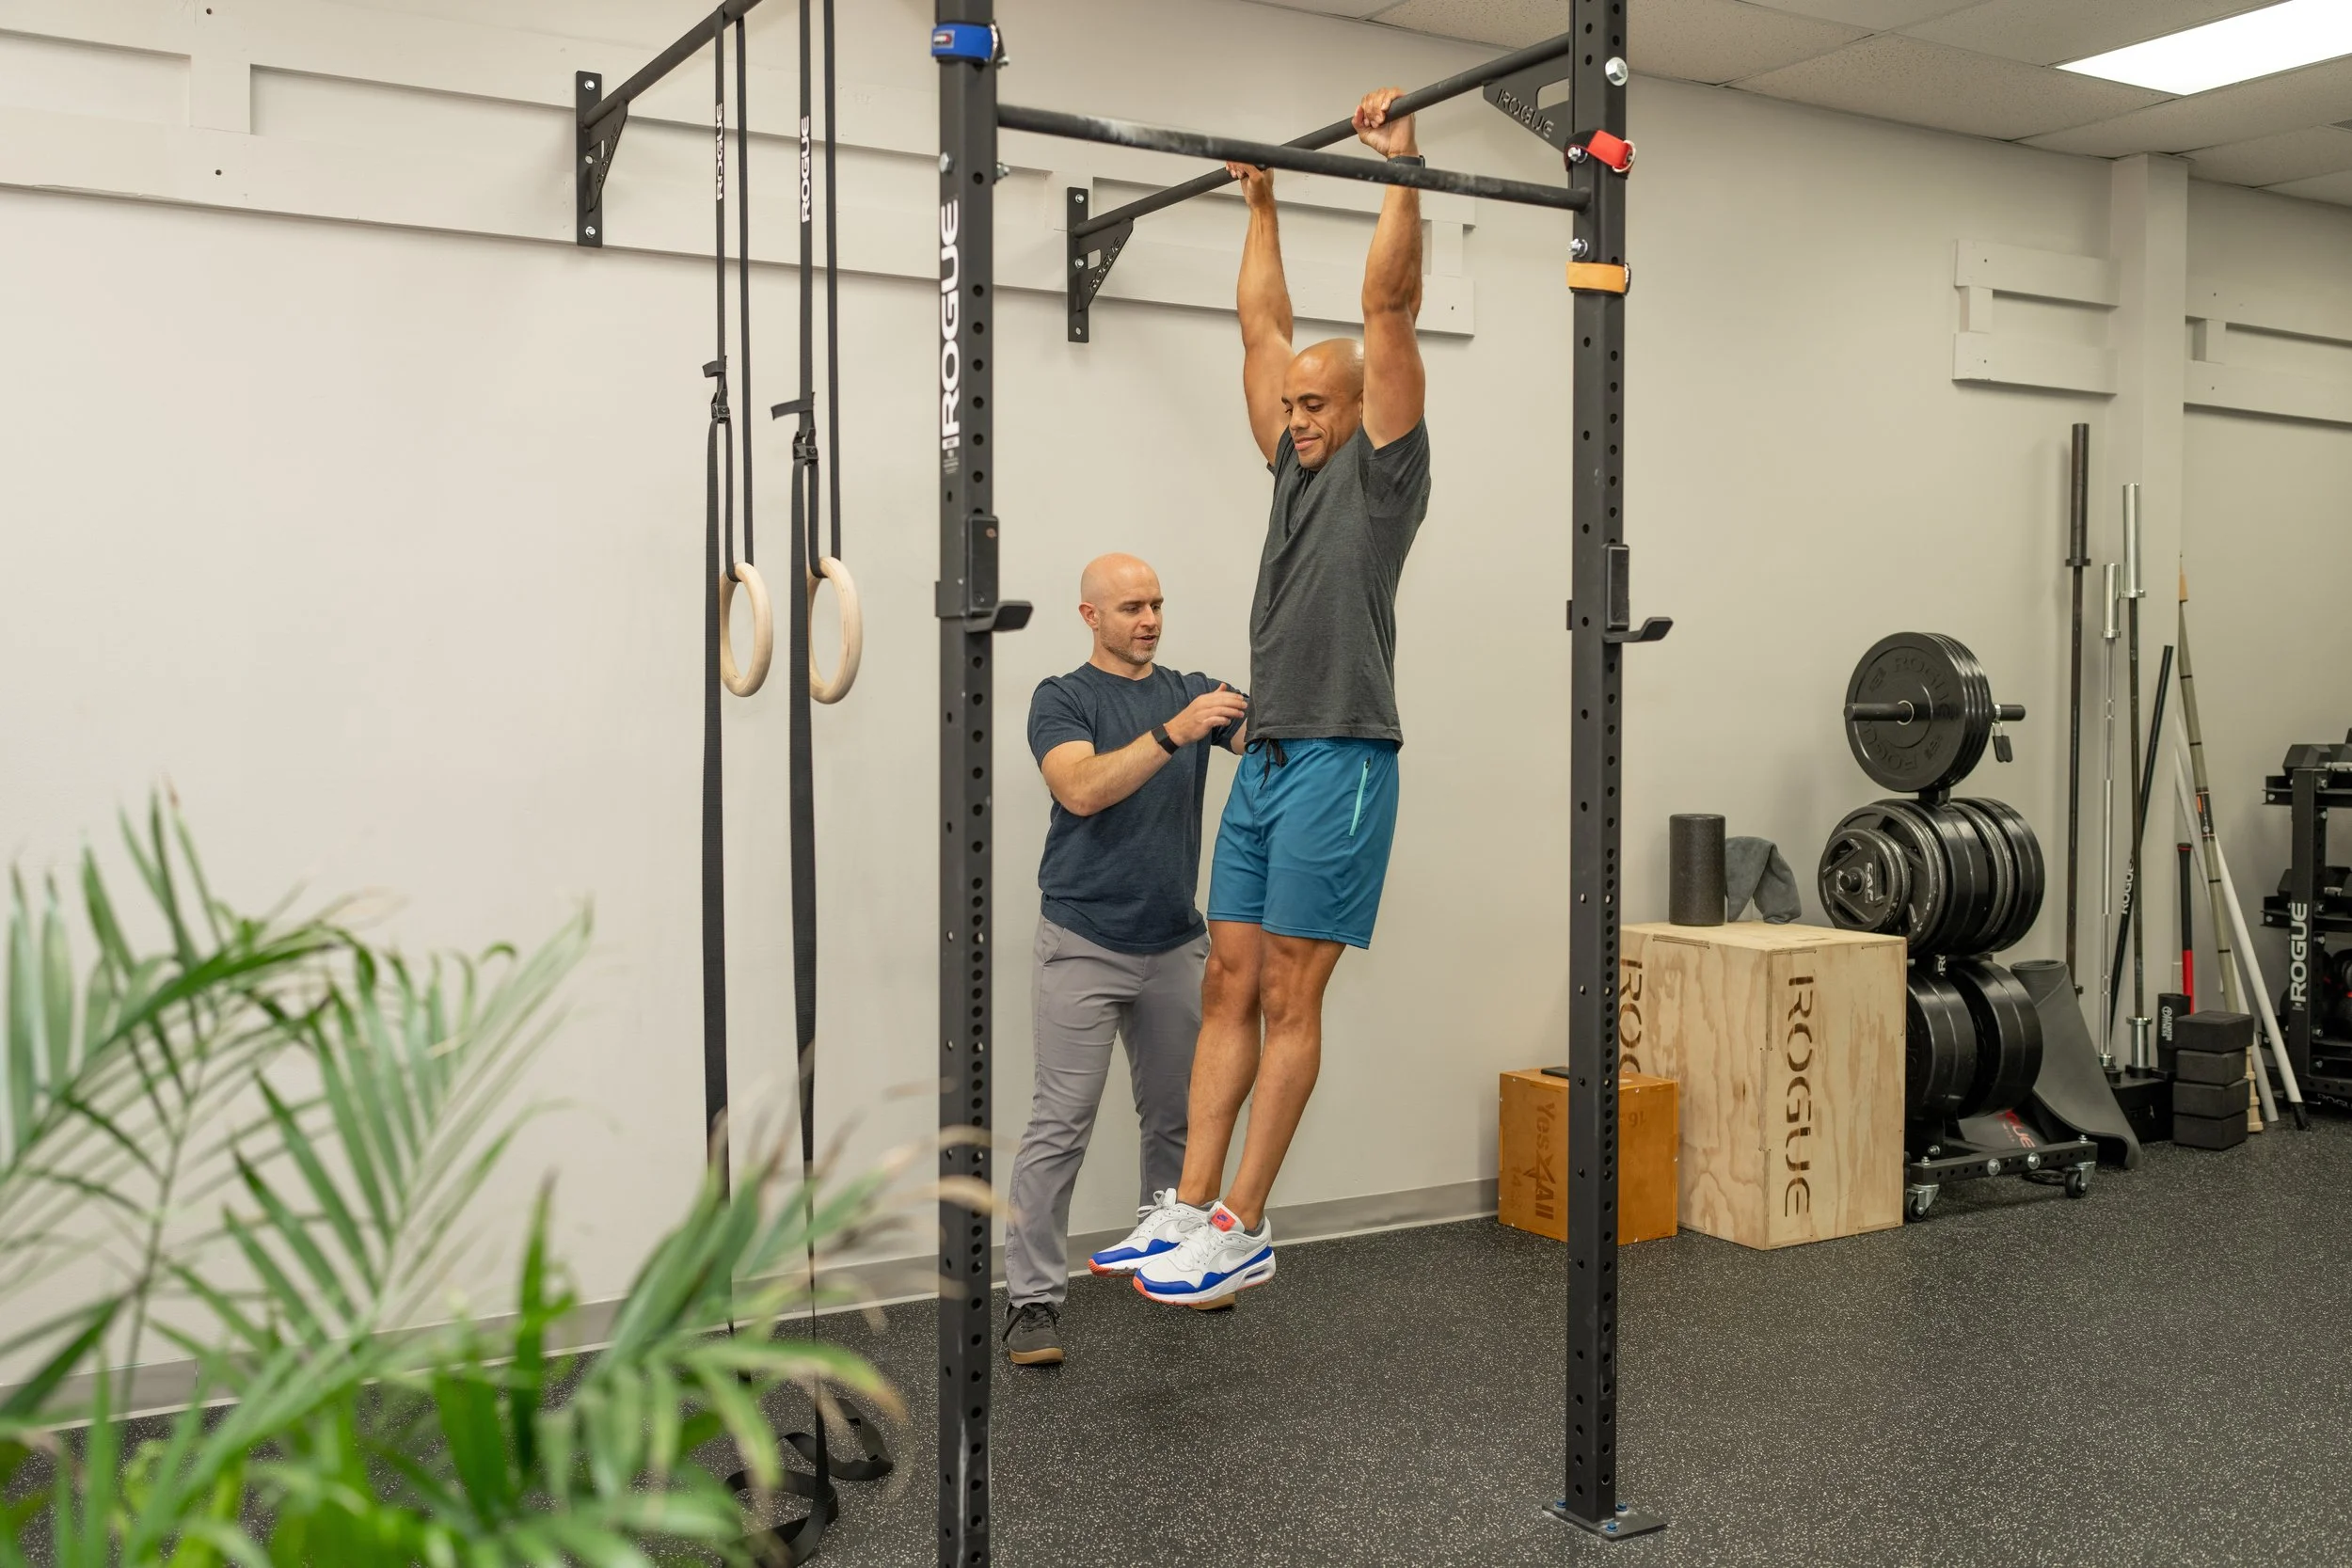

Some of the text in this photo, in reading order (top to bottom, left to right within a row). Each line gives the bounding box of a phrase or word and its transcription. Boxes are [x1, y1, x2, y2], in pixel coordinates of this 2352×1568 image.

[1497, 88, 1554, 138] ROGUE
[801, 115, 810, 223] ROGUE
[941, 199, 960, 437] ROGUE
[1089, 235, 1120, 293] ROGUE
[2290, 901, 2308, 1003] ROGUE
[1786, 975, 1814, 1218] ROGUE
[1524, 1102, 1556, 1221] Yes4All
